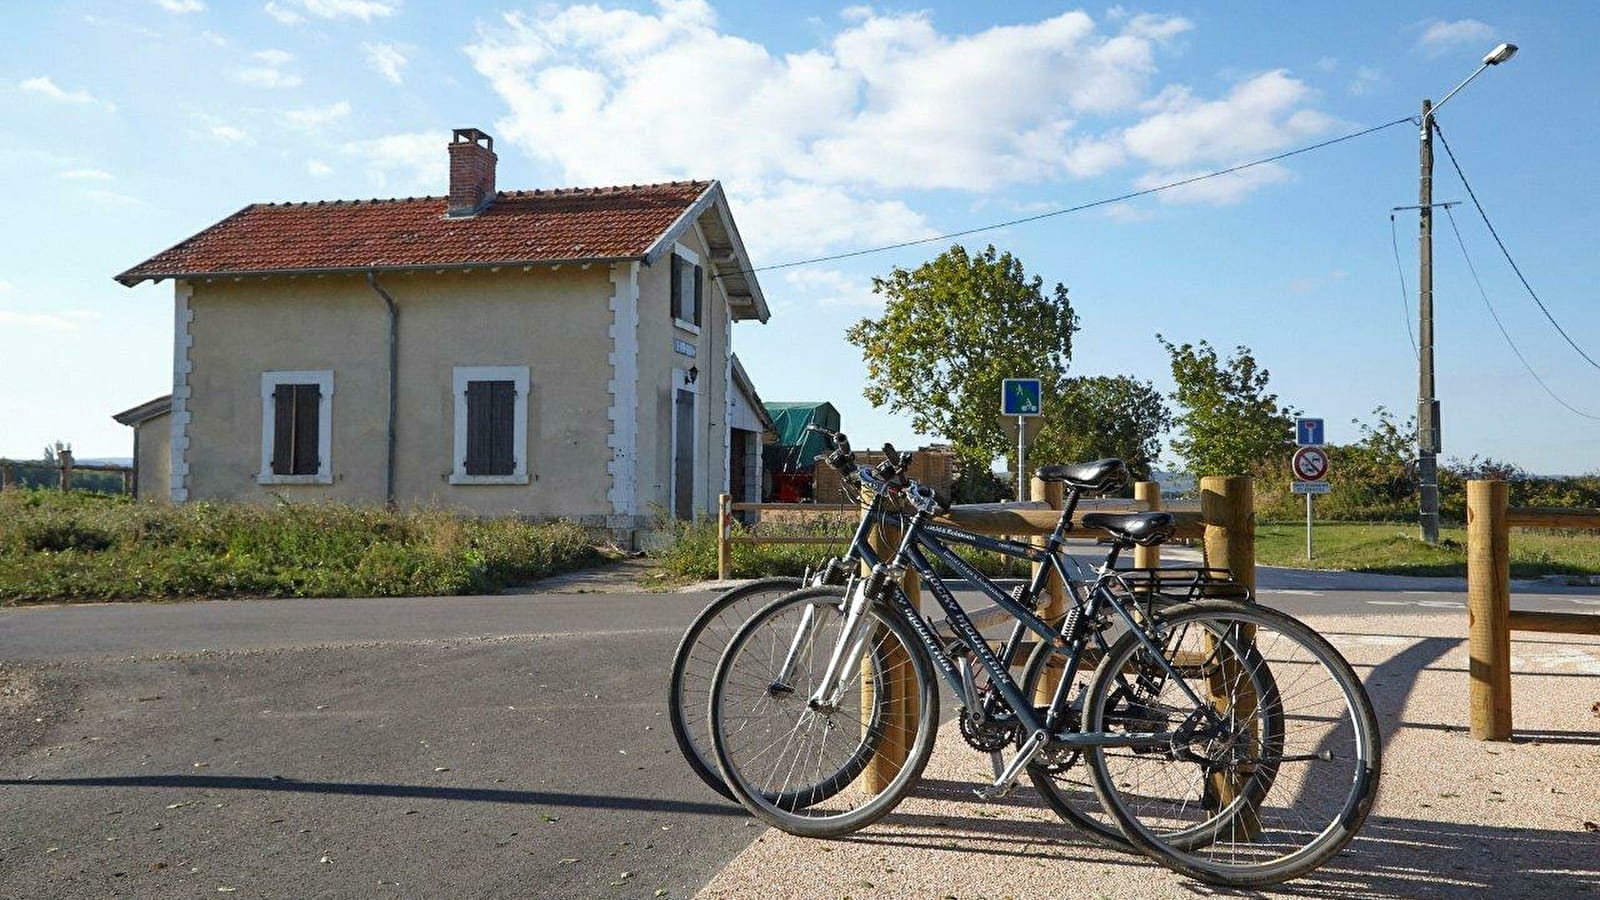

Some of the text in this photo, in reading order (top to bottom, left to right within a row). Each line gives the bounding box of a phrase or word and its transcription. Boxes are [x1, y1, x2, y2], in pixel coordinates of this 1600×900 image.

[904, 608, 953, 672] MOUNTAIN
[922, 569, 958, 610] ROCKY
[956, 614, 1011, 684] MOUNTAIN
